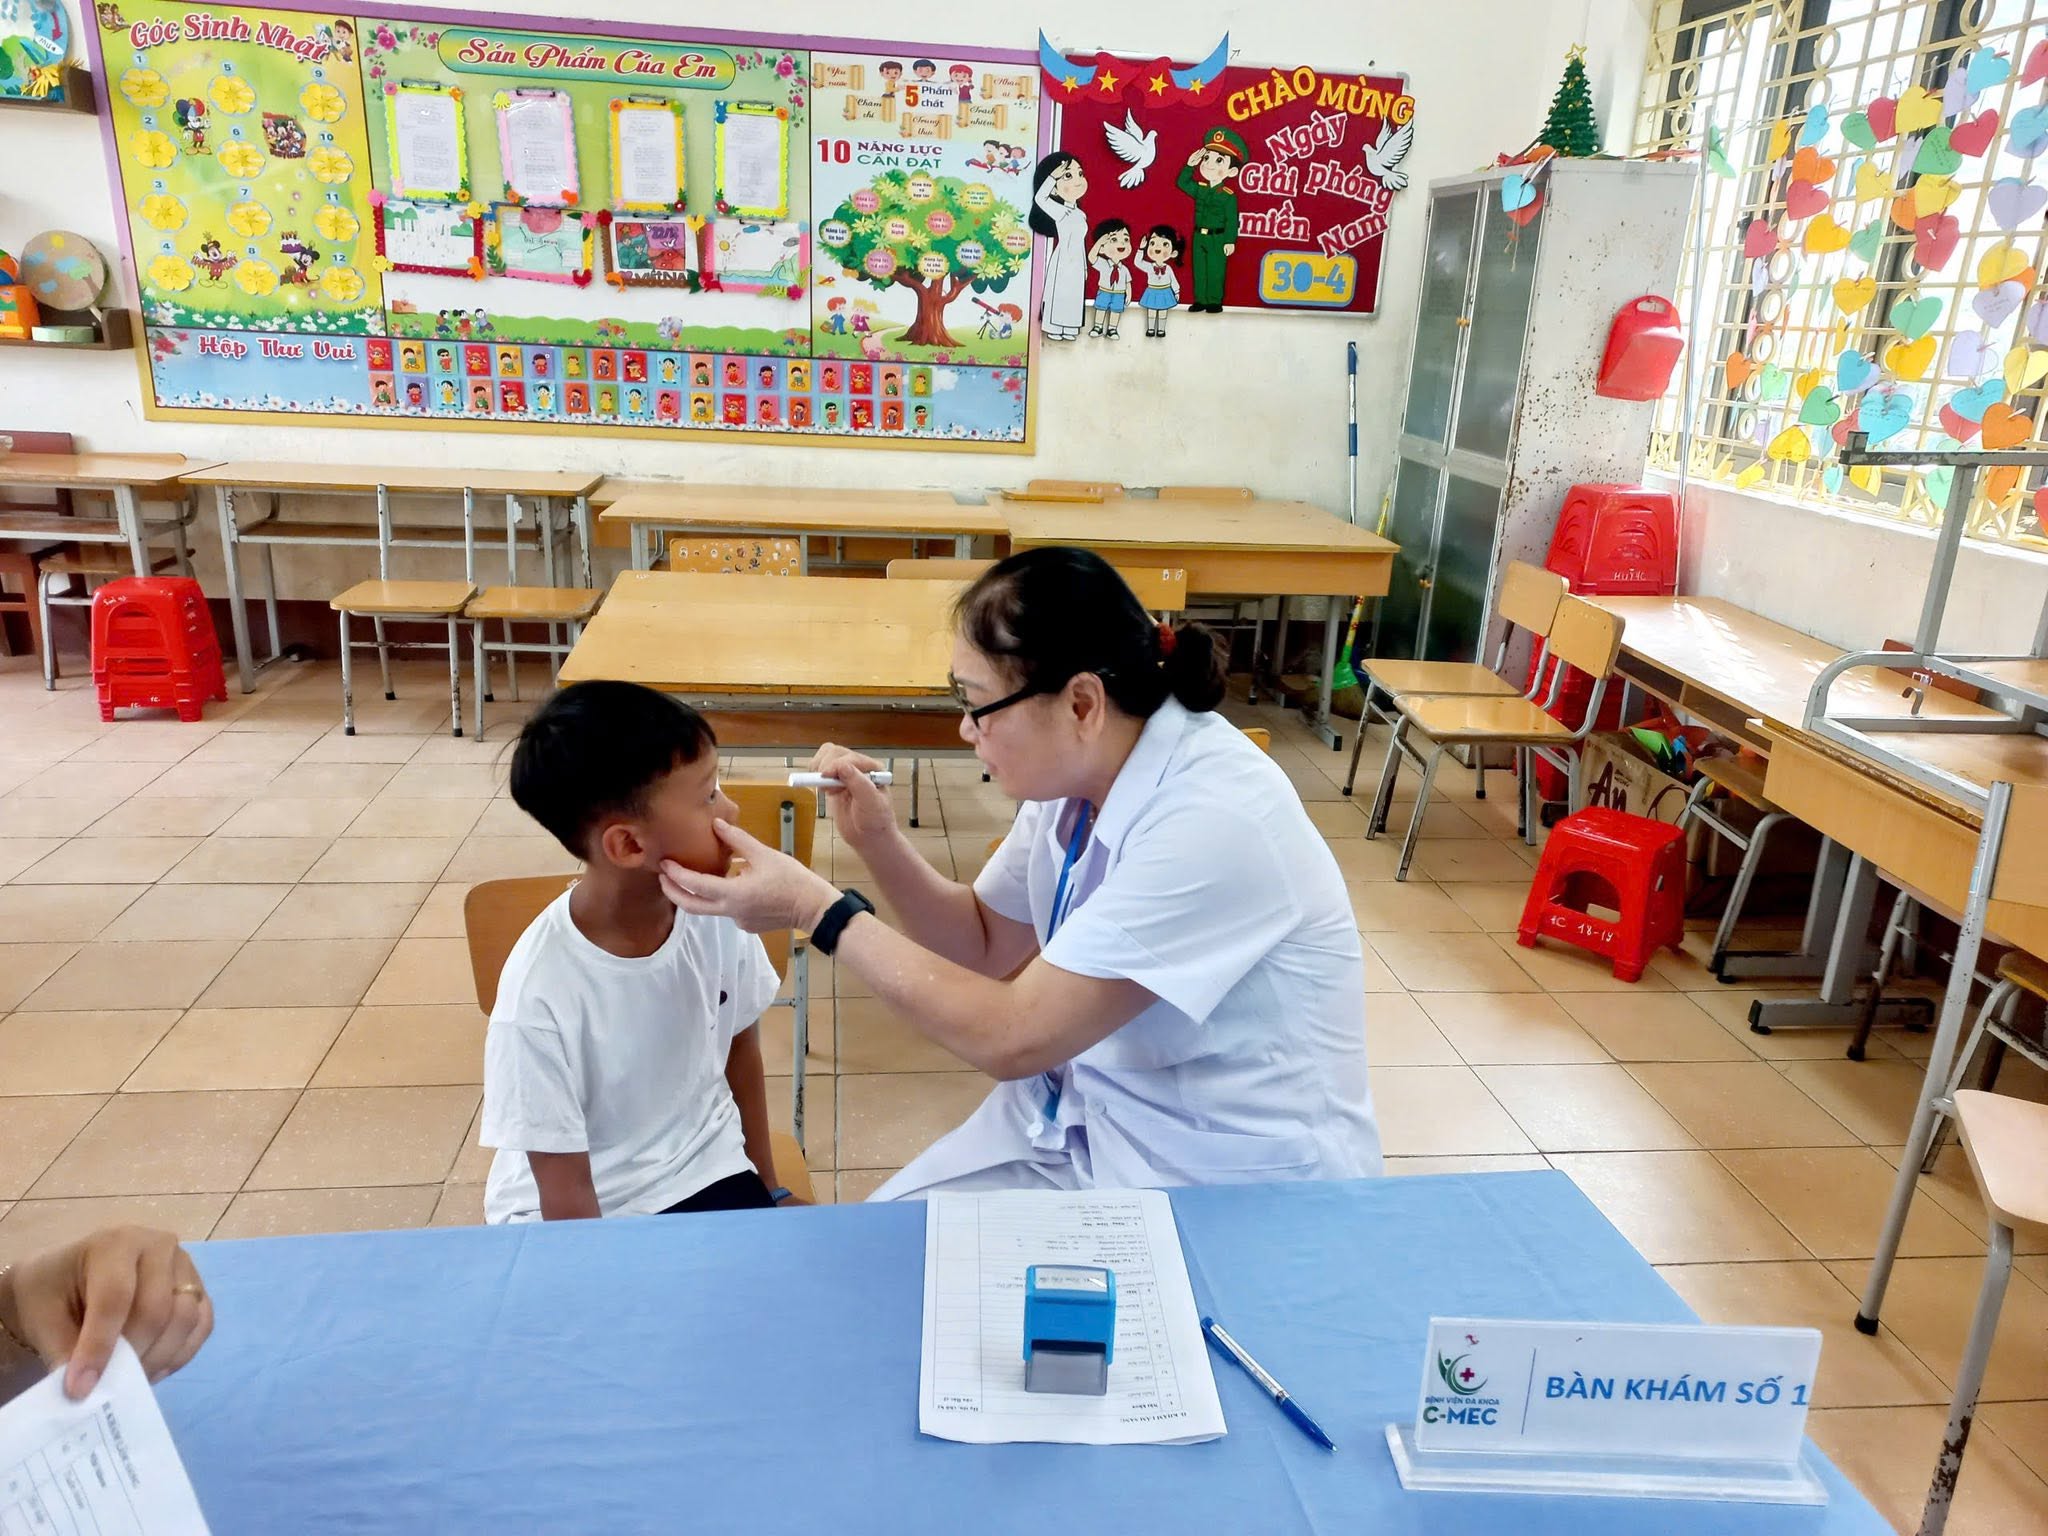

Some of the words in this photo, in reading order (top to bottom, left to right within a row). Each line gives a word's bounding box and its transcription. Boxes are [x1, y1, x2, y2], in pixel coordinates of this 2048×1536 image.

[130, 17, 179, 49] Góc
[184, 13, 250, 40] Sinh
[255, 20, 330, 63] Nhật
[223, 63, 232, 72] 5
[458, 37, 518, 65] Sản
[523, 42, 607, 70] Phẩm
[613, 49, 666, 75] Của
[673, 53, 717, 78] Em
[315, 70, 323, 78] 9
[905, 85, 919, 107] 5
[1226, 65, 1316, 123] CHÀO
[1319, 75, 1416, 126] MỪNG
[145, 117, 153, 125] 2
[232, 128, 240, 136] 6
[320, 133, 333, 141] 10
[1265, 110, 1348, 164] Ngày
[817, 138, 852, 164] 10
[857, 140, 905, 153] NĂNG
[910, 144, 943, 157] LỰC
[857, 152, 899, 167] CẦN
[906, 157, 942, 171] ĐẠT
[154, 181, 162, 189] 3
[241, 188, 249, 196] 7
[1305, 161, 1394, 215] phóng
[326, 193, 339, 201] 11
[1238, 200, 1311, 242] miền
[1317, 211, 1389, 261] Nam
[163, 242, 171, 250] 4
[248, 247, 256, 255] 8
[332, 254, 346, 262] 12
[1272, 260, 1348, 294] 30-4
[199, 335, 246, 360] Hộp
[257, 338, 303, 358] Thư
[312, 341, 356, 360] Vui
[1545, 1370, 1615, 1400] BÀN
[1623, 1373, 1728, 1404] KHÁM
[1735, 1374, 1785, 1406] SỐ
[1790, 1384, 1808, 1406] 1
[1422, 1405, 1498, 1426] C-MEC
